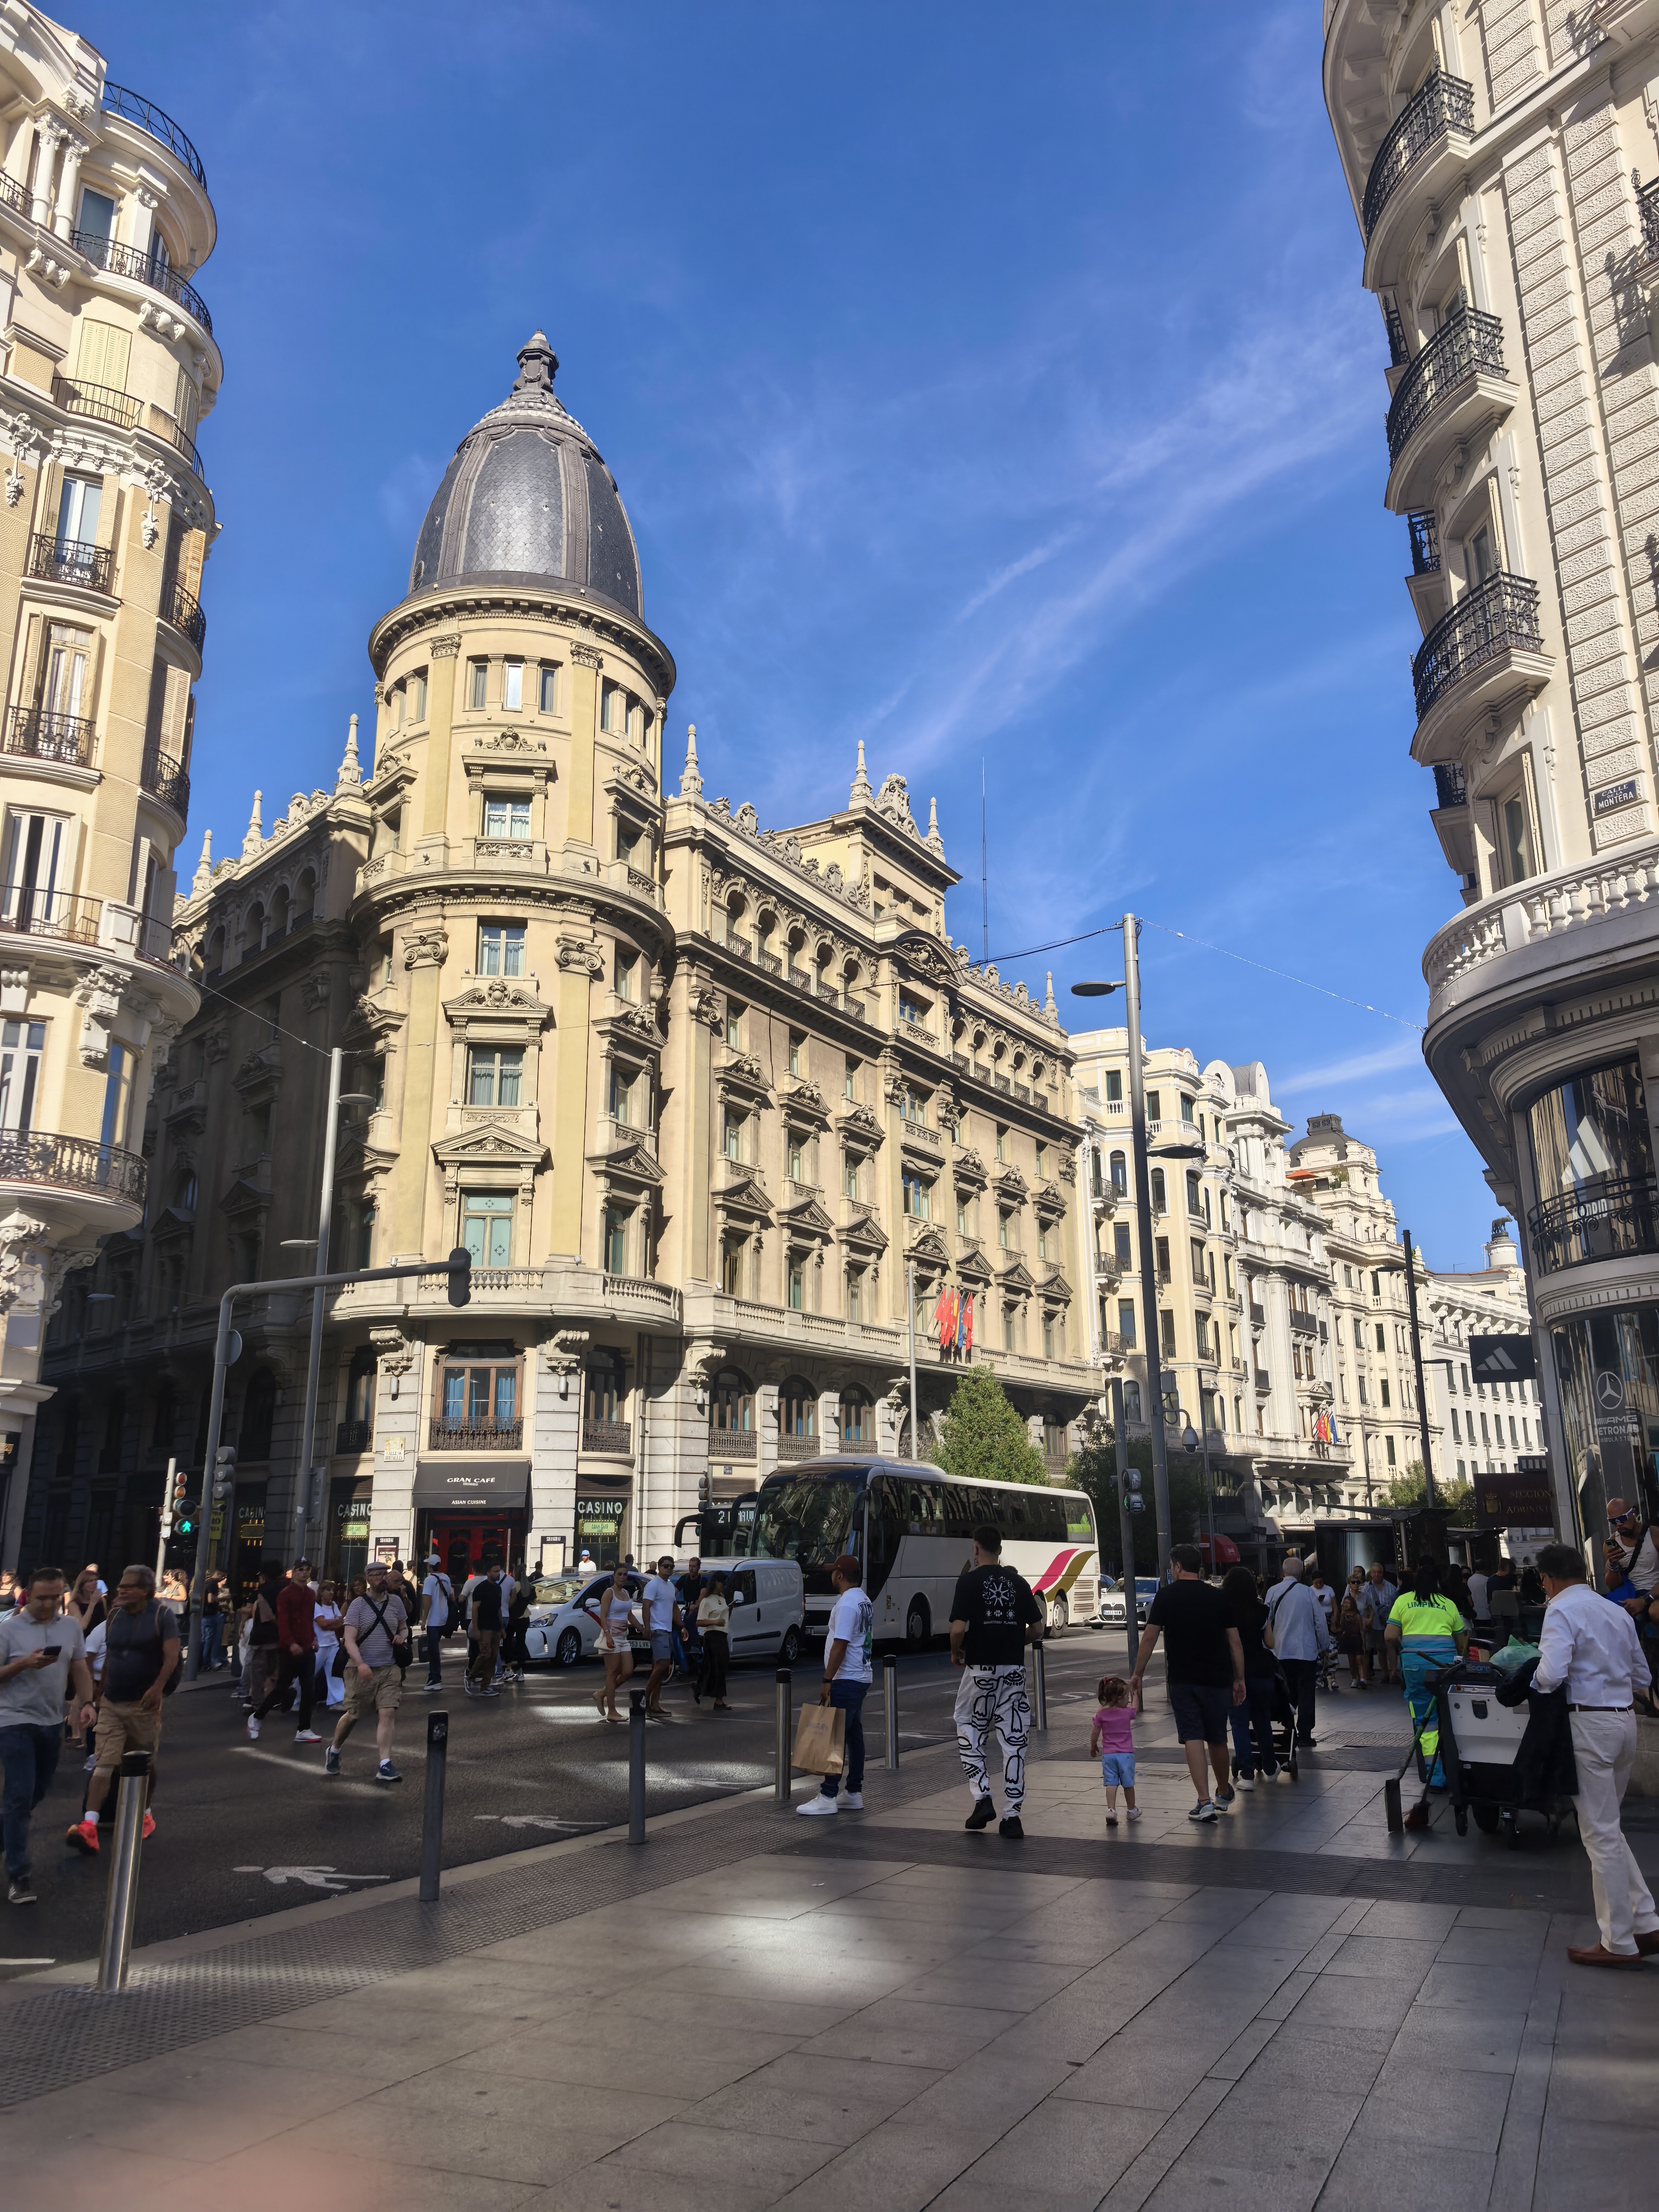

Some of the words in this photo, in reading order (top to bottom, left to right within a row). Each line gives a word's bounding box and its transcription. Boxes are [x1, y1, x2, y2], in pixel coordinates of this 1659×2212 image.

[1602, 784, 1628, 797] CALLE
[1599, 791, 1634, 810] MONTERA
[1597, 1424, 1640, 1435] ETRONAS
[239, 1506, 266, 1519] CASIN
[577, 1501, 623, 1514] CASINO
[1407, 1601, 1447, 1611] LIMPIEZA
